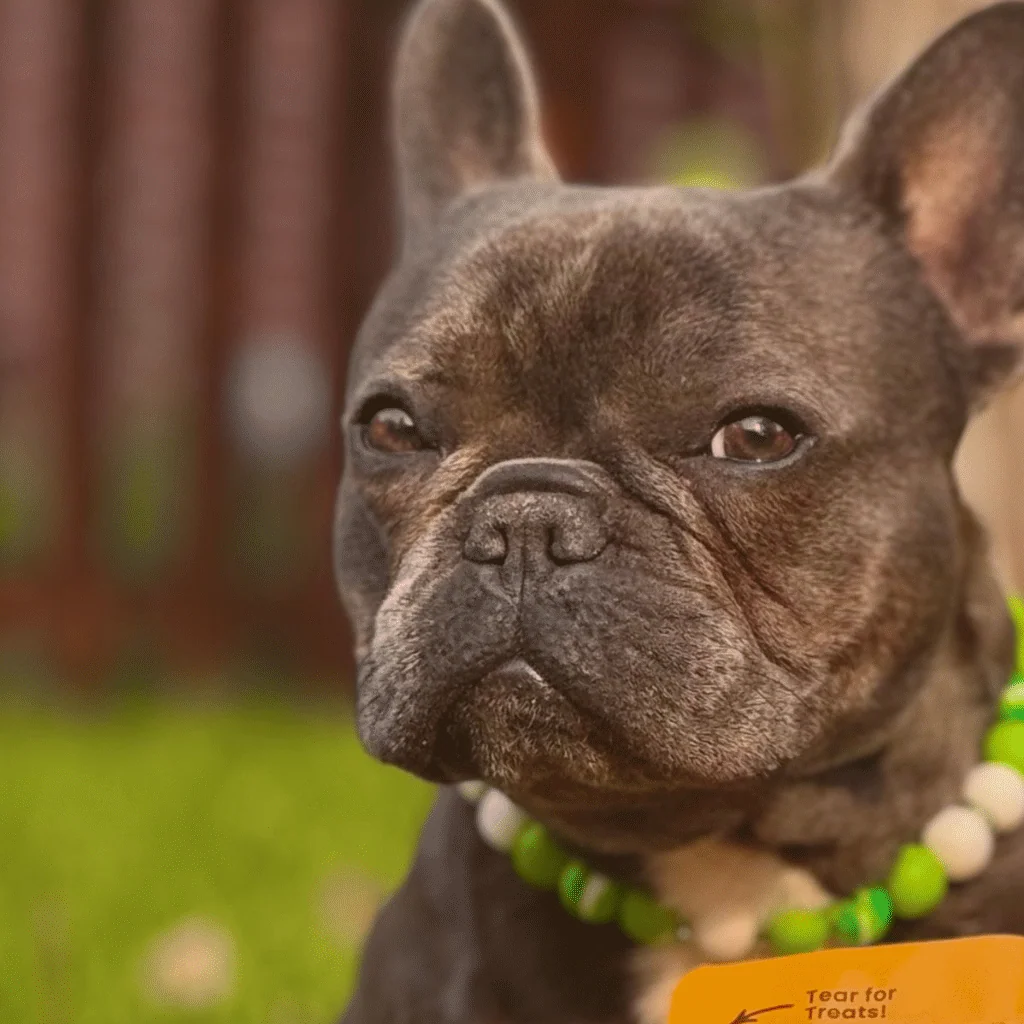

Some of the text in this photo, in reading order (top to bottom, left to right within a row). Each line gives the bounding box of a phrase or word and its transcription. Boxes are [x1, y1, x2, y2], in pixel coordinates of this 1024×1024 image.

[806, 987, 897, 1004] Tear for
[805, 1004, 886, 1020] Treats!
